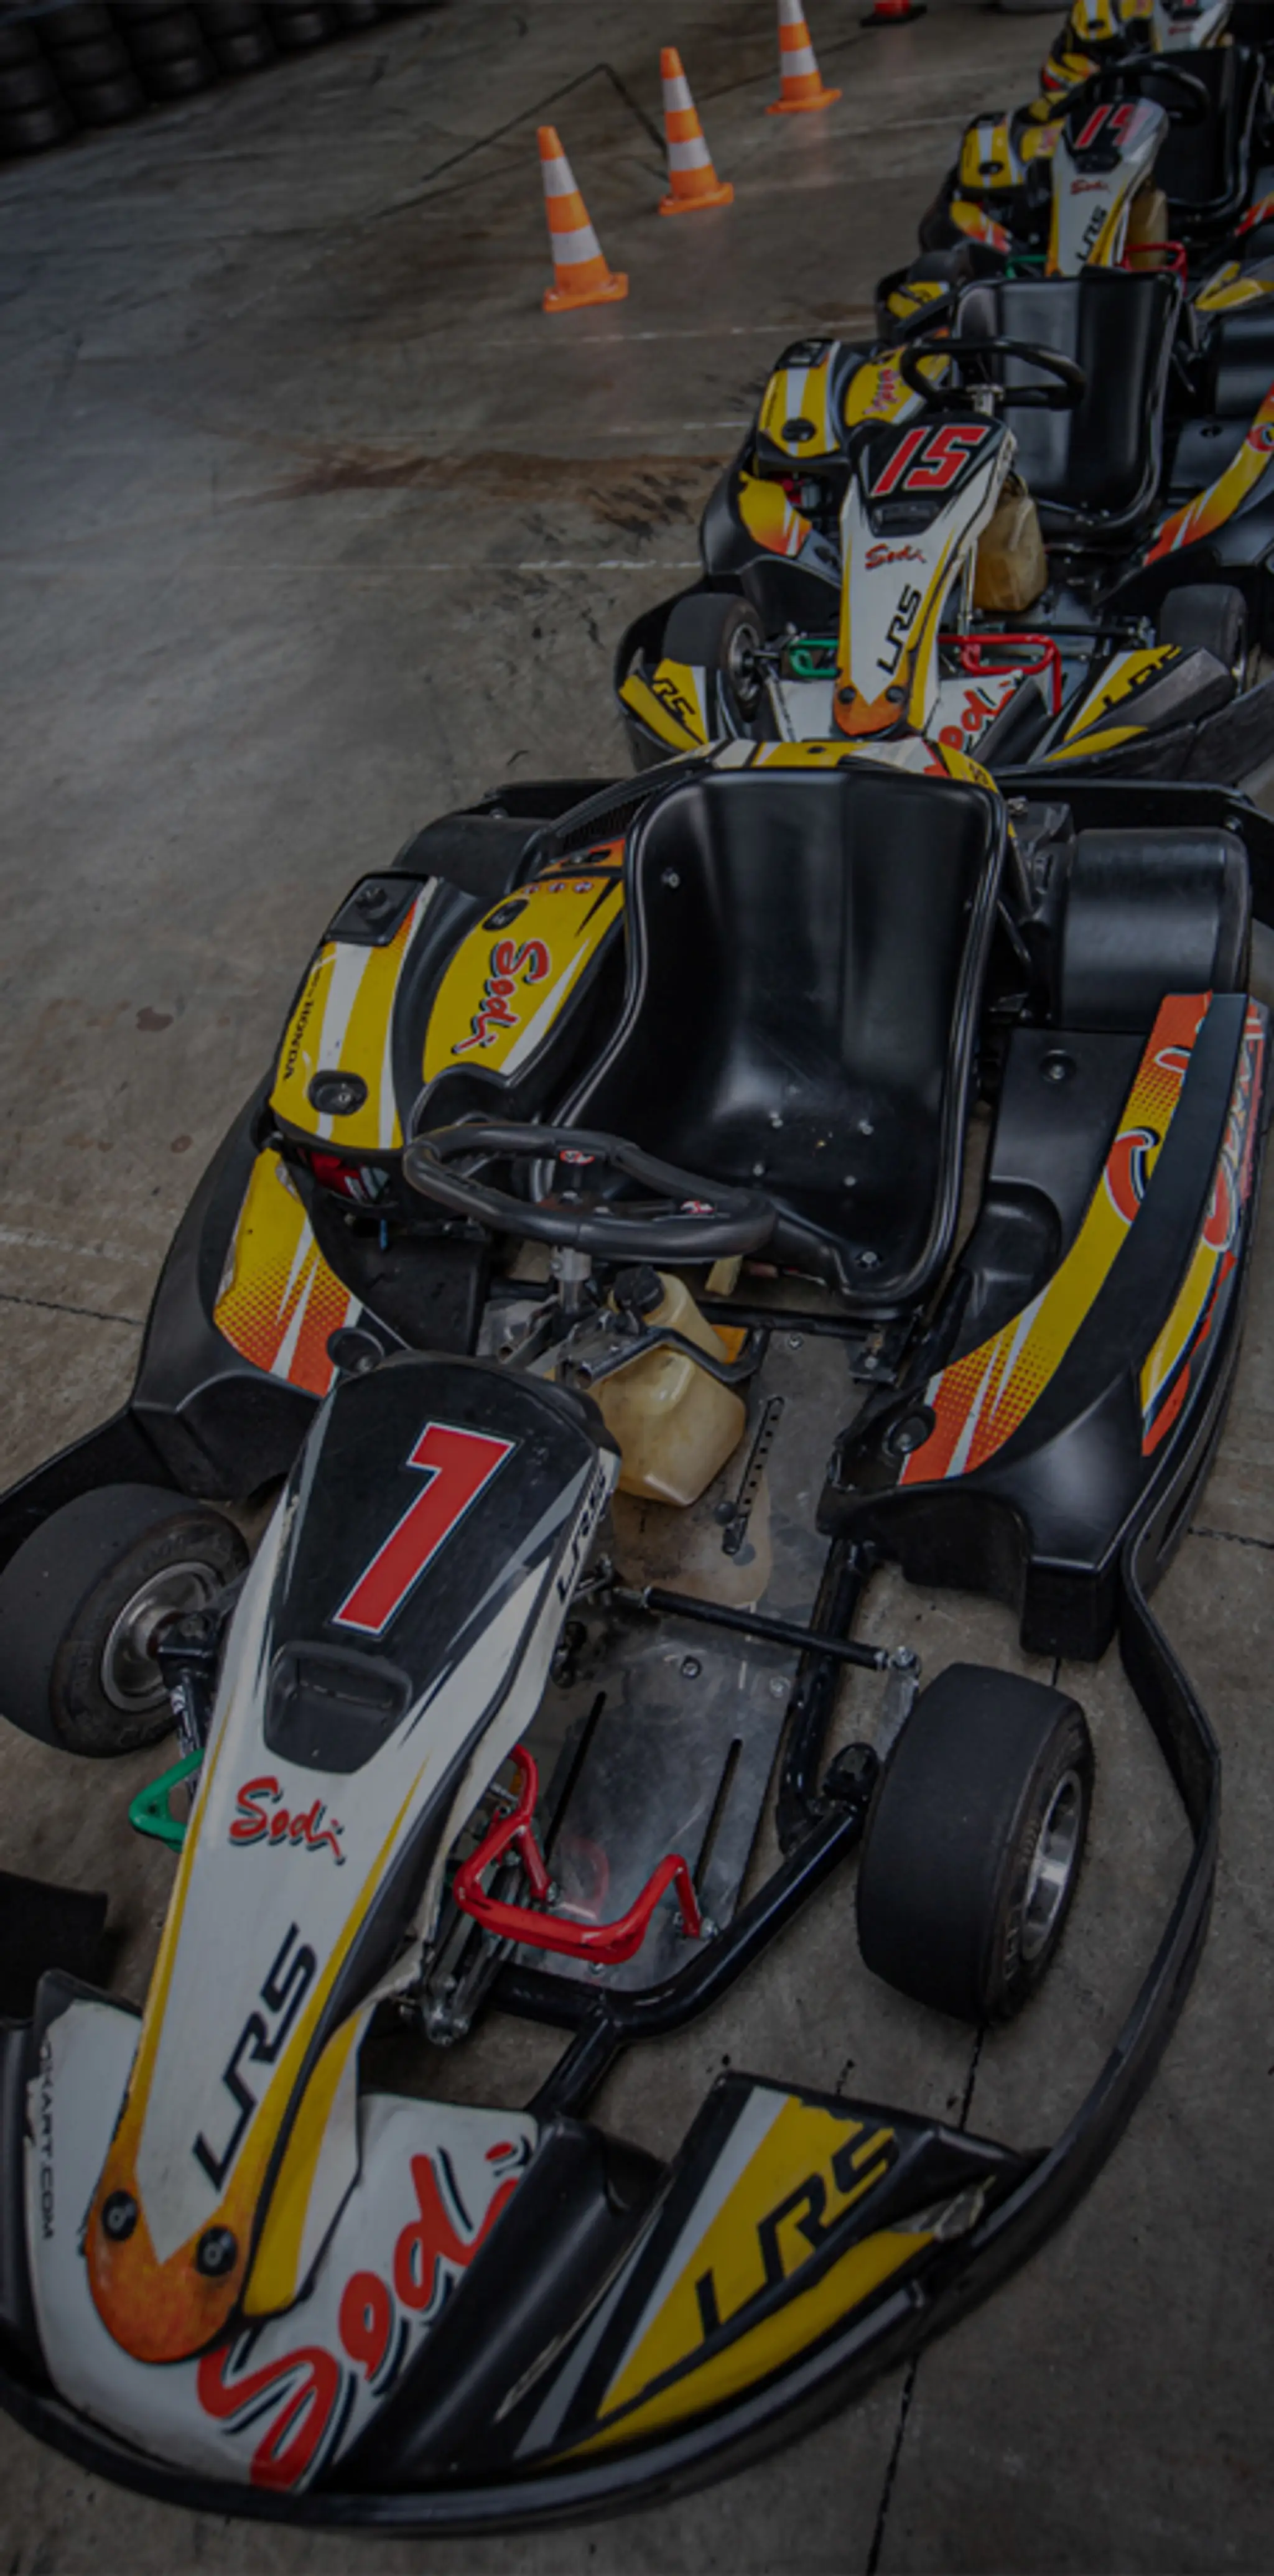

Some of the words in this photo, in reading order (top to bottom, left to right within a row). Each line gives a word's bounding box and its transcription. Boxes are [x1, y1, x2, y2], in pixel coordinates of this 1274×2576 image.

[871, 425, 990, 498] 15
[865, 544, 927, 570] Sodi
[877, 584, 923, 676] LRS
[283, 1000, 314, 1081] HONDA
[451, 939, 551, 1056] Sodi
[330, 1421, 518, 1636] 1
[228, 1776, 346, 1865] Sodi
[190, 1921, 318, 2192] LRS
[695, 2120, 899, 2341] LRS
[198, 2135, 533, 2493] Sodi
